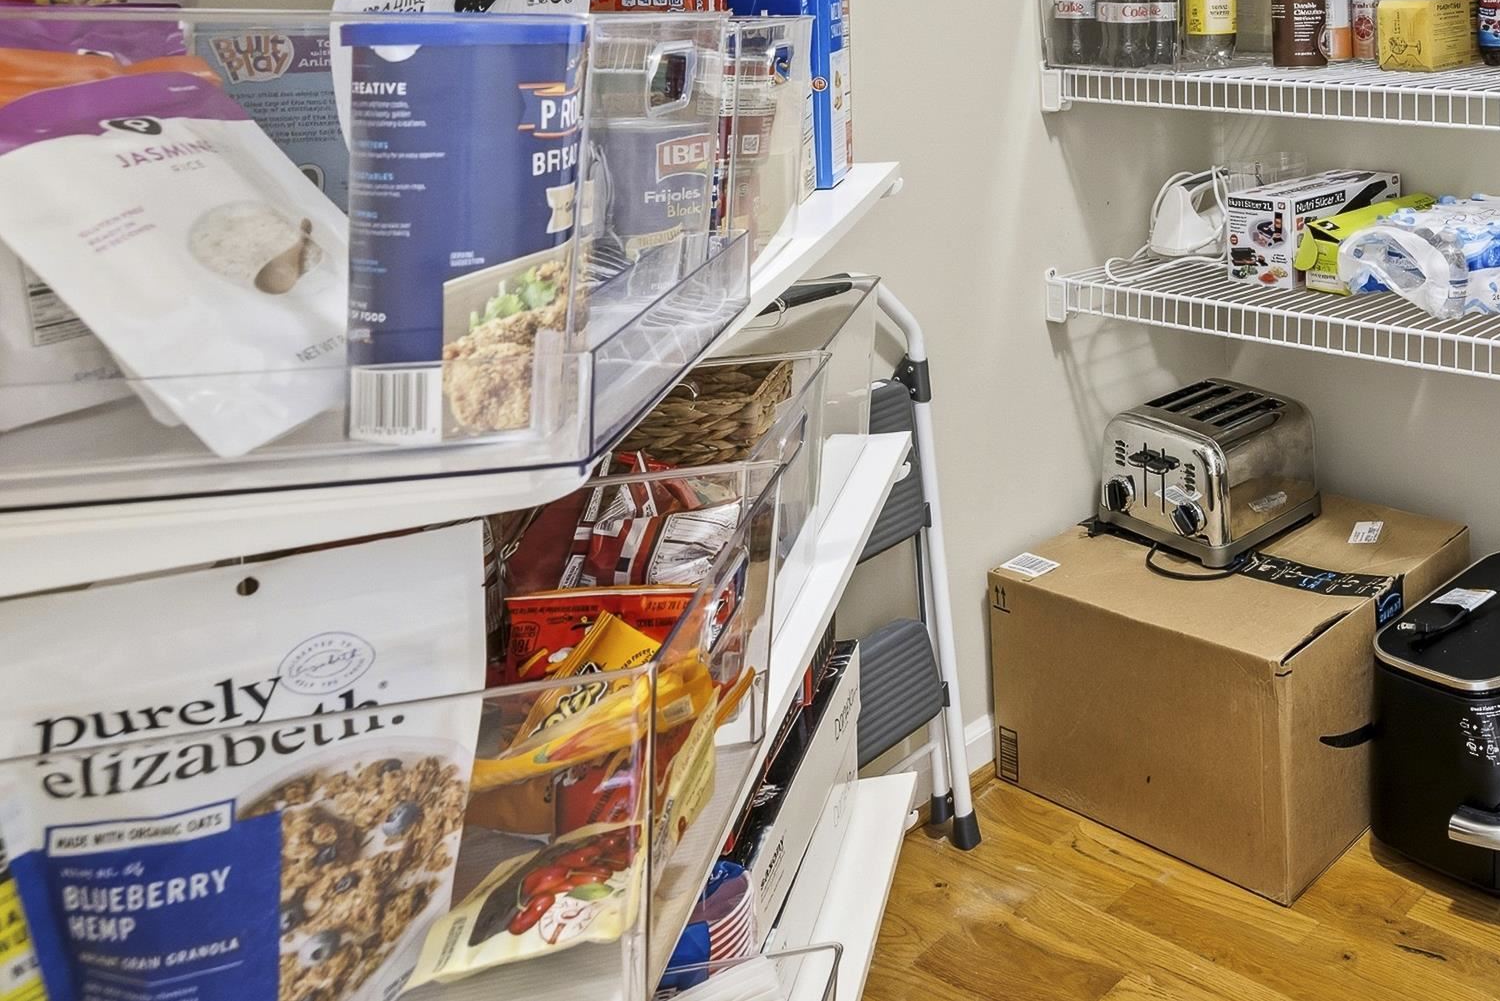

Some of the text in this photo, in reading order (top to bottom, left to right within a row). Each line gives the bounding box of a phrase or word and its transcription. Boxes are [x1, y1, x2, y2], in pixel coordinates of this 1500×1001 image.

[644, 187, 701, 206] Frijoles
[1296, 191, 1346, 213] Nutri Slicer XL
[35, 675, 282, 766] purely
[186, 812, 223, 832] OATS
[62, 865, 232, 913] BLUEBERRY
[68, 916, 136, 943] HEMP
[165, 937, 241, 968] GRANOLA
